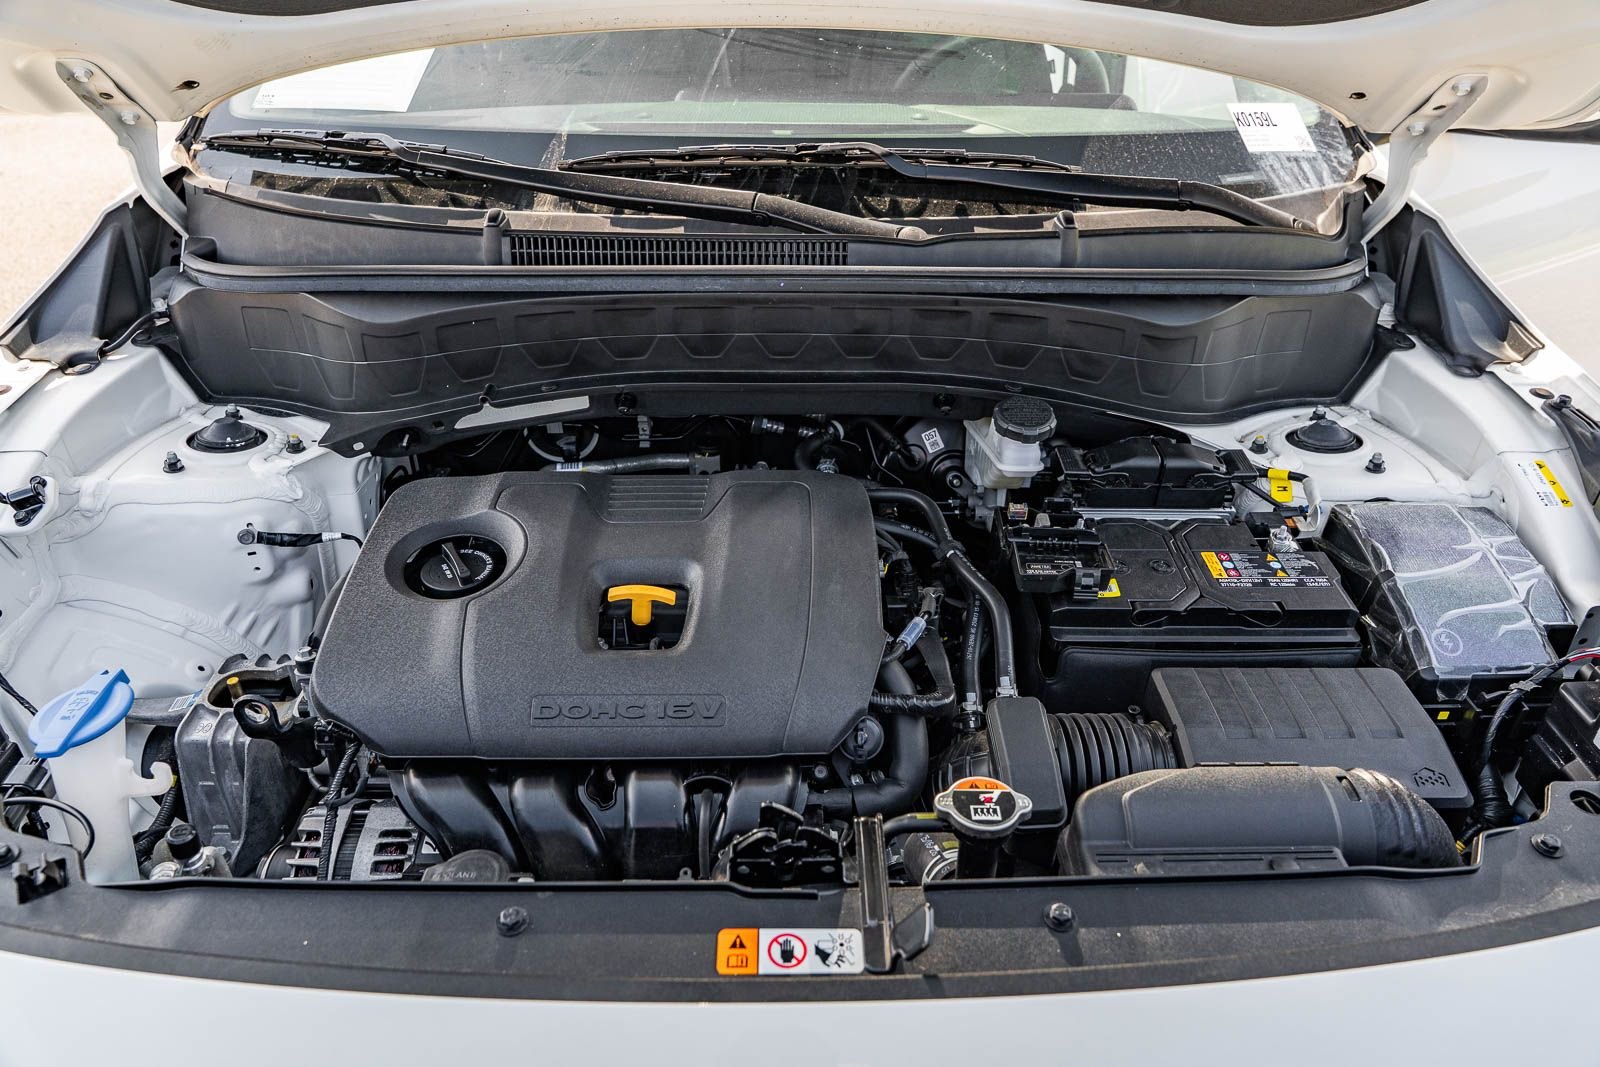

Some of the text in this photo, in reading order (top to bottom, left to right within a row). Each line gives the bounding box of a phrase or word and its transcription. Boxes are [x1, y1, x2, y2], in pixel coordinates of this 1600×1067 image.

[1233, 111, 1278, 127] K0159L
[534, 701, 723, 720] DOHC 16V
